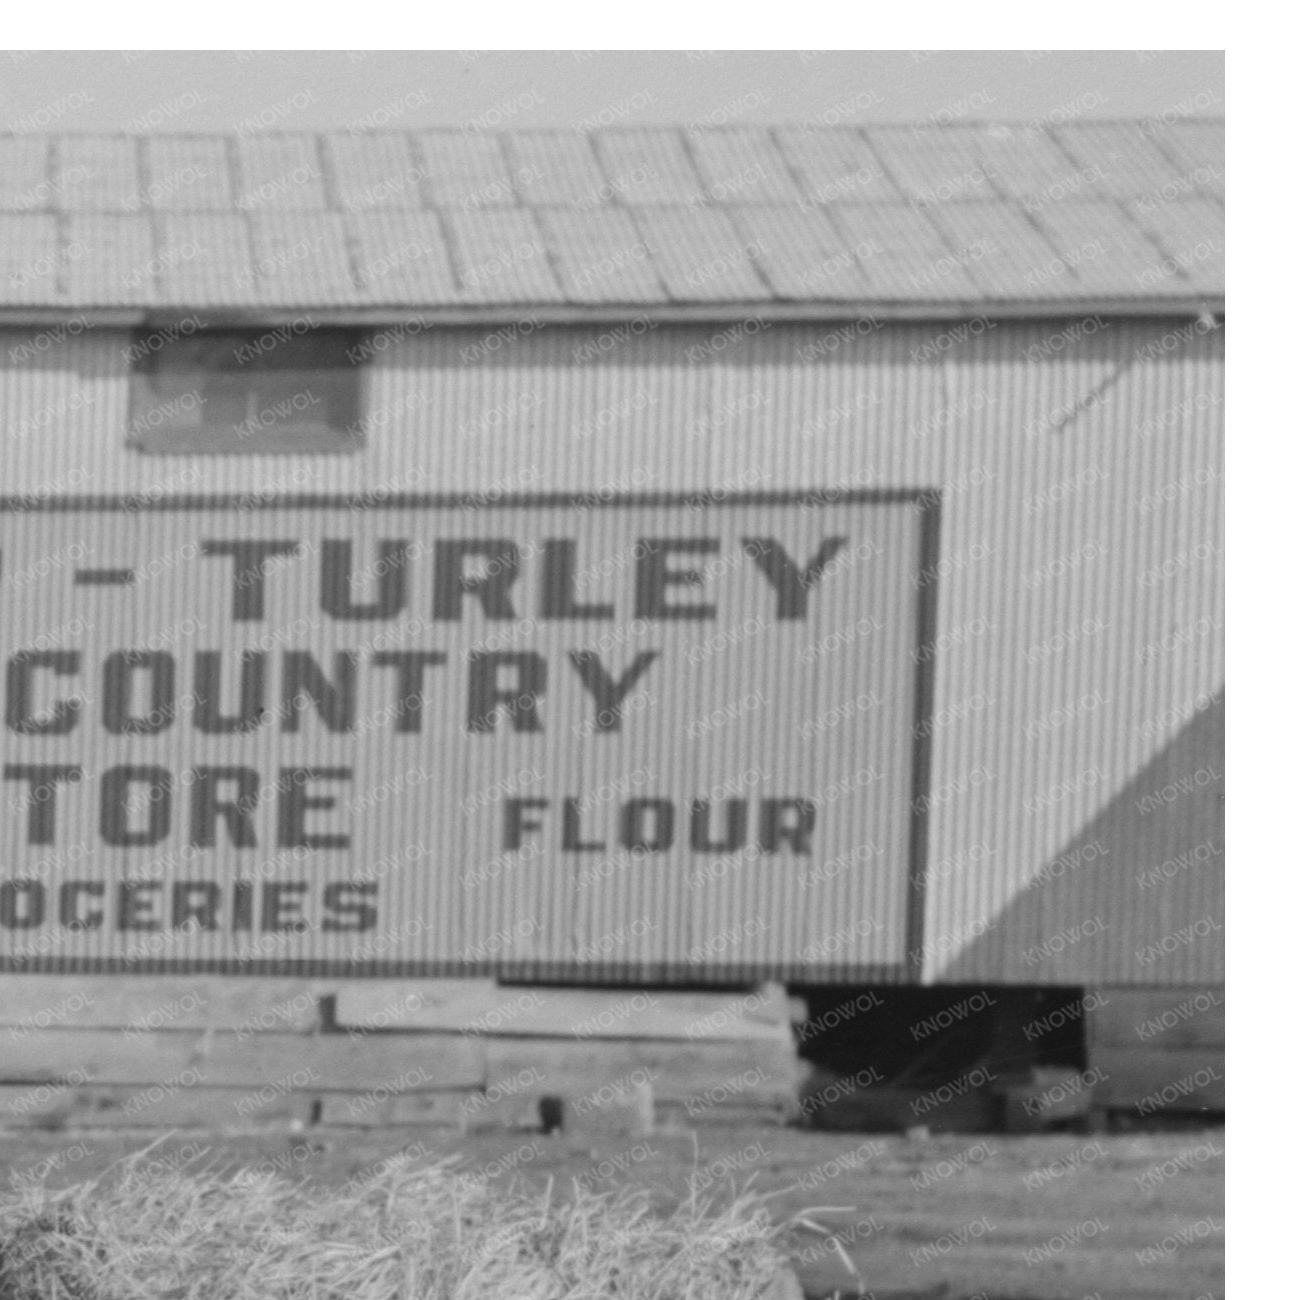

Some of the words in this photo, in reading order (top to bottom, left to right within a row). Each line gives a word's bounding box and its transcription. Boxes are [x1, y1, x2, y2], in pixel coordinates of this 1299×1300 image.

[201, 535, 849, 624] TURLEY
[4, 649, 659, 737] COUNTRY
[503, 796, 816, 856] FLOUR
